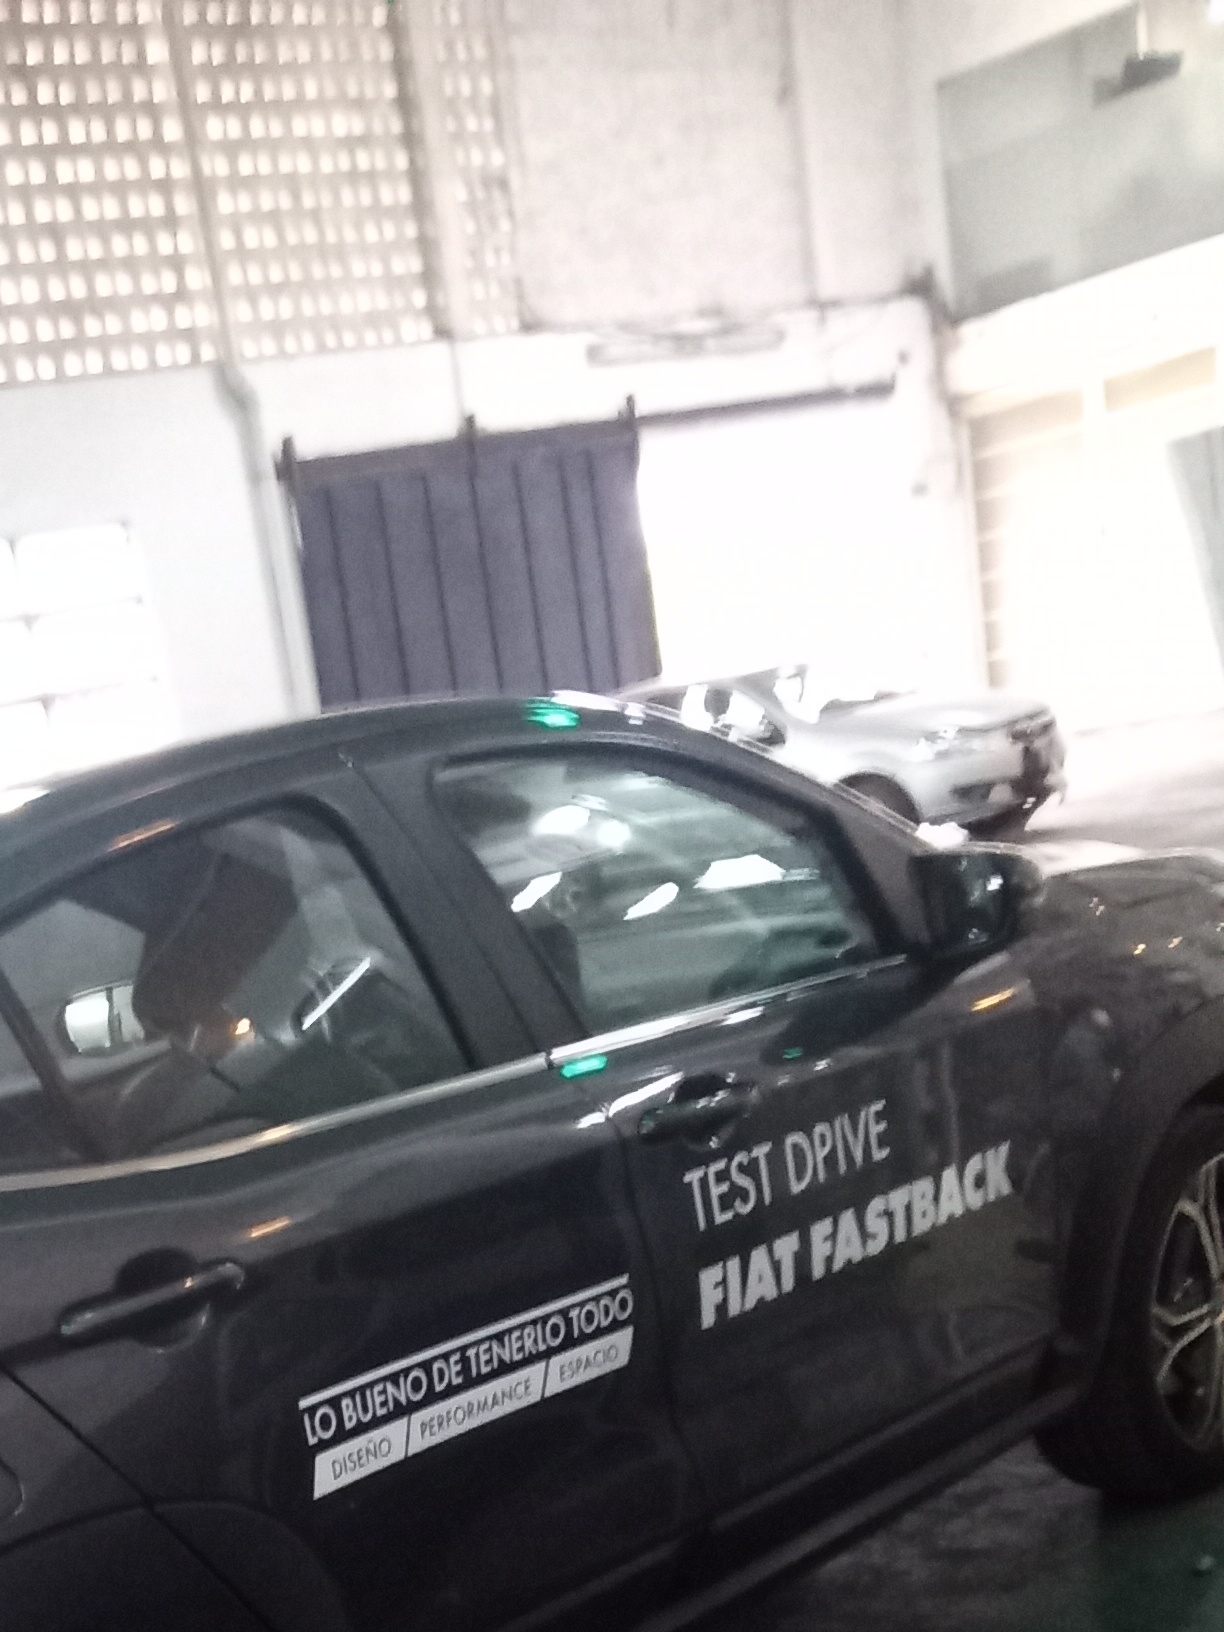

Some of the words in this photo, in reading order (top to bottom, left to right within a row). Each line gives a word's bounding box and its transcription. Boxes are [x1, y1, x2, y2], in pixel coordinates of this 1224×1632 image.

[683, 1141, 772, 1232] TEST
[698, 1231, 800, 1331] FIAT
[810, 1140, 1013, 1281] FASTBACK
[303, 1403, 338, 1447] LO
[341, 1367, 429, 1432] BUENO
[432, 1350, 466, 1392] DE
[465, 1317, 567, 1378] TENERLO
[568, 1288, 634, 1339] TODO
[330, 1435, 392, 1481] DISEÑO
[419, 1376, 532, 1442] PERFORMANCE
[558, 1344, 619, 1383] ESPACIO
